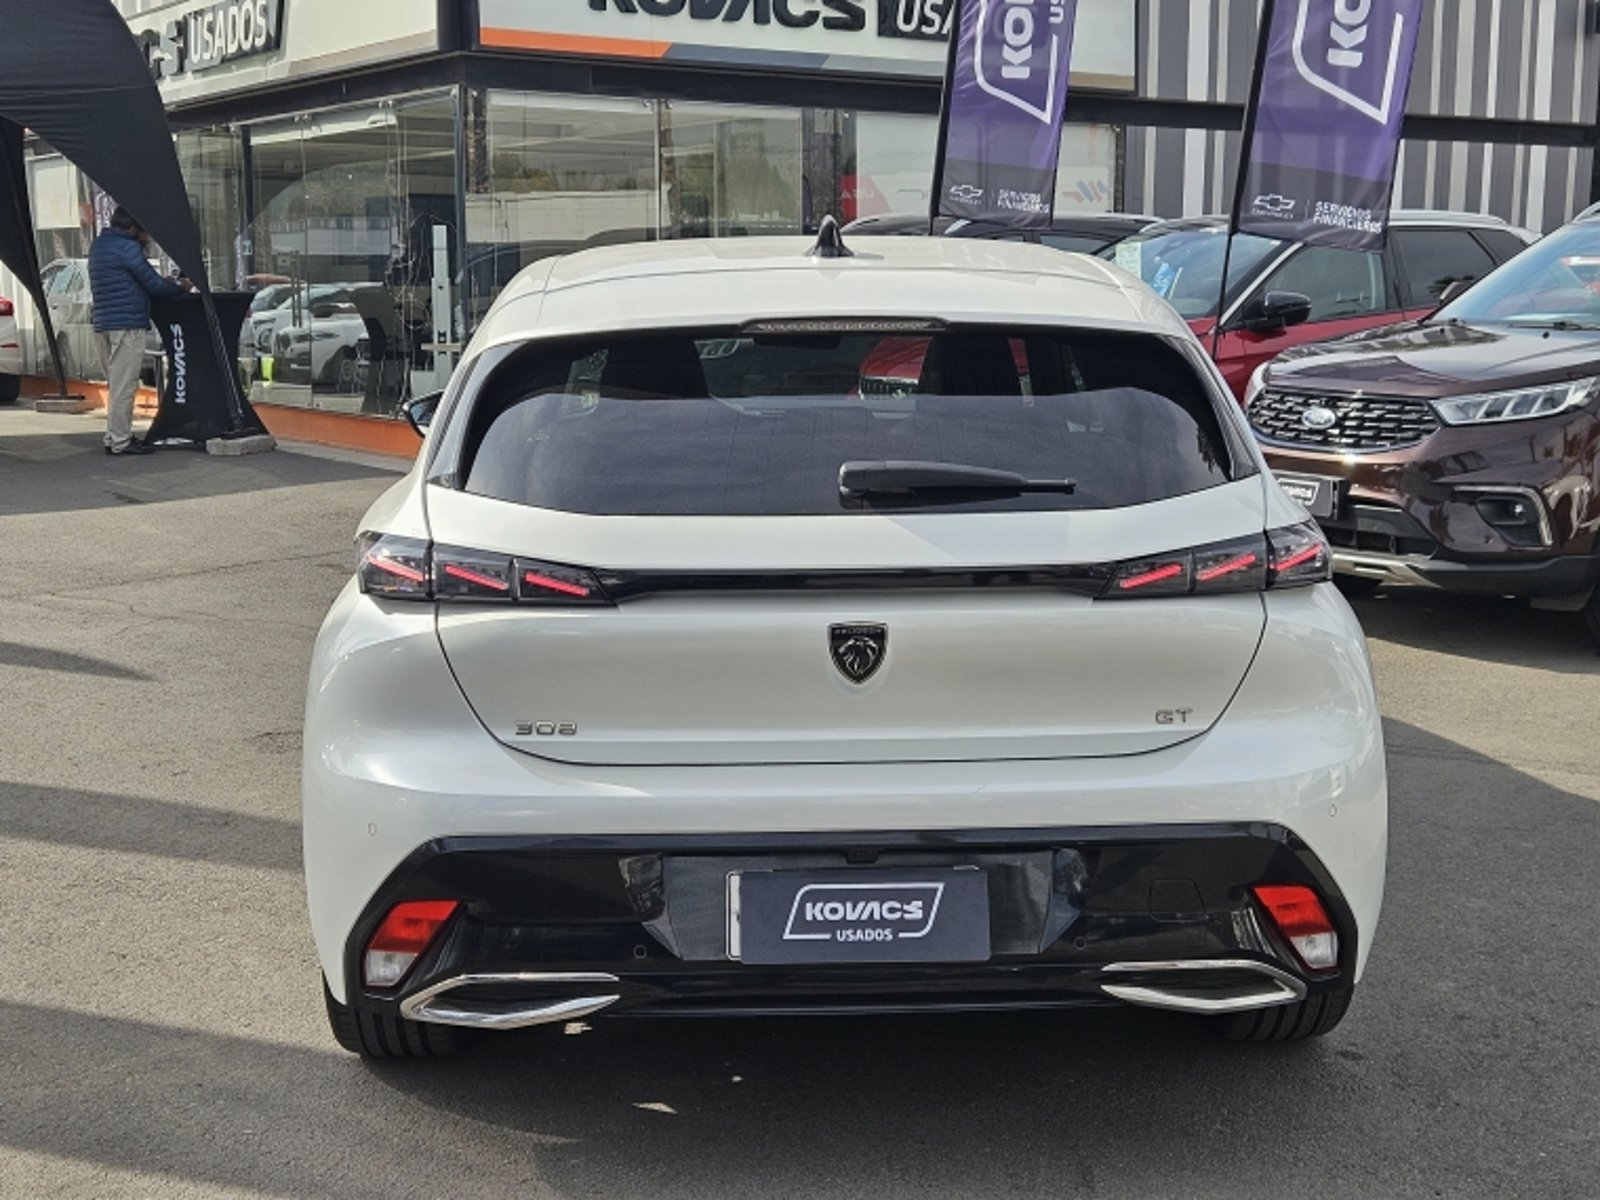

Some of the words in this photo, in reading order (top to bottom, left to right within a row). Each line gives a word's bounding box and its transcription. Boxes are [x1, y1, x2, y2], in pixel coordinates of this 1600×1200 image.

[190, 0, 267, 63] USADOS
[1315, 201, 1372, 220] SERVICIOS
[1313, 212, 1382, 234] FINANCIEROS
[169, 323, 187, 404] KOVACS
[1155, 708, 1194, 725] GT
[514, 720, 577, 736] 308
[805, 900, 924, 922] KOVACS
[836, 928, 894, 943] USADOS
